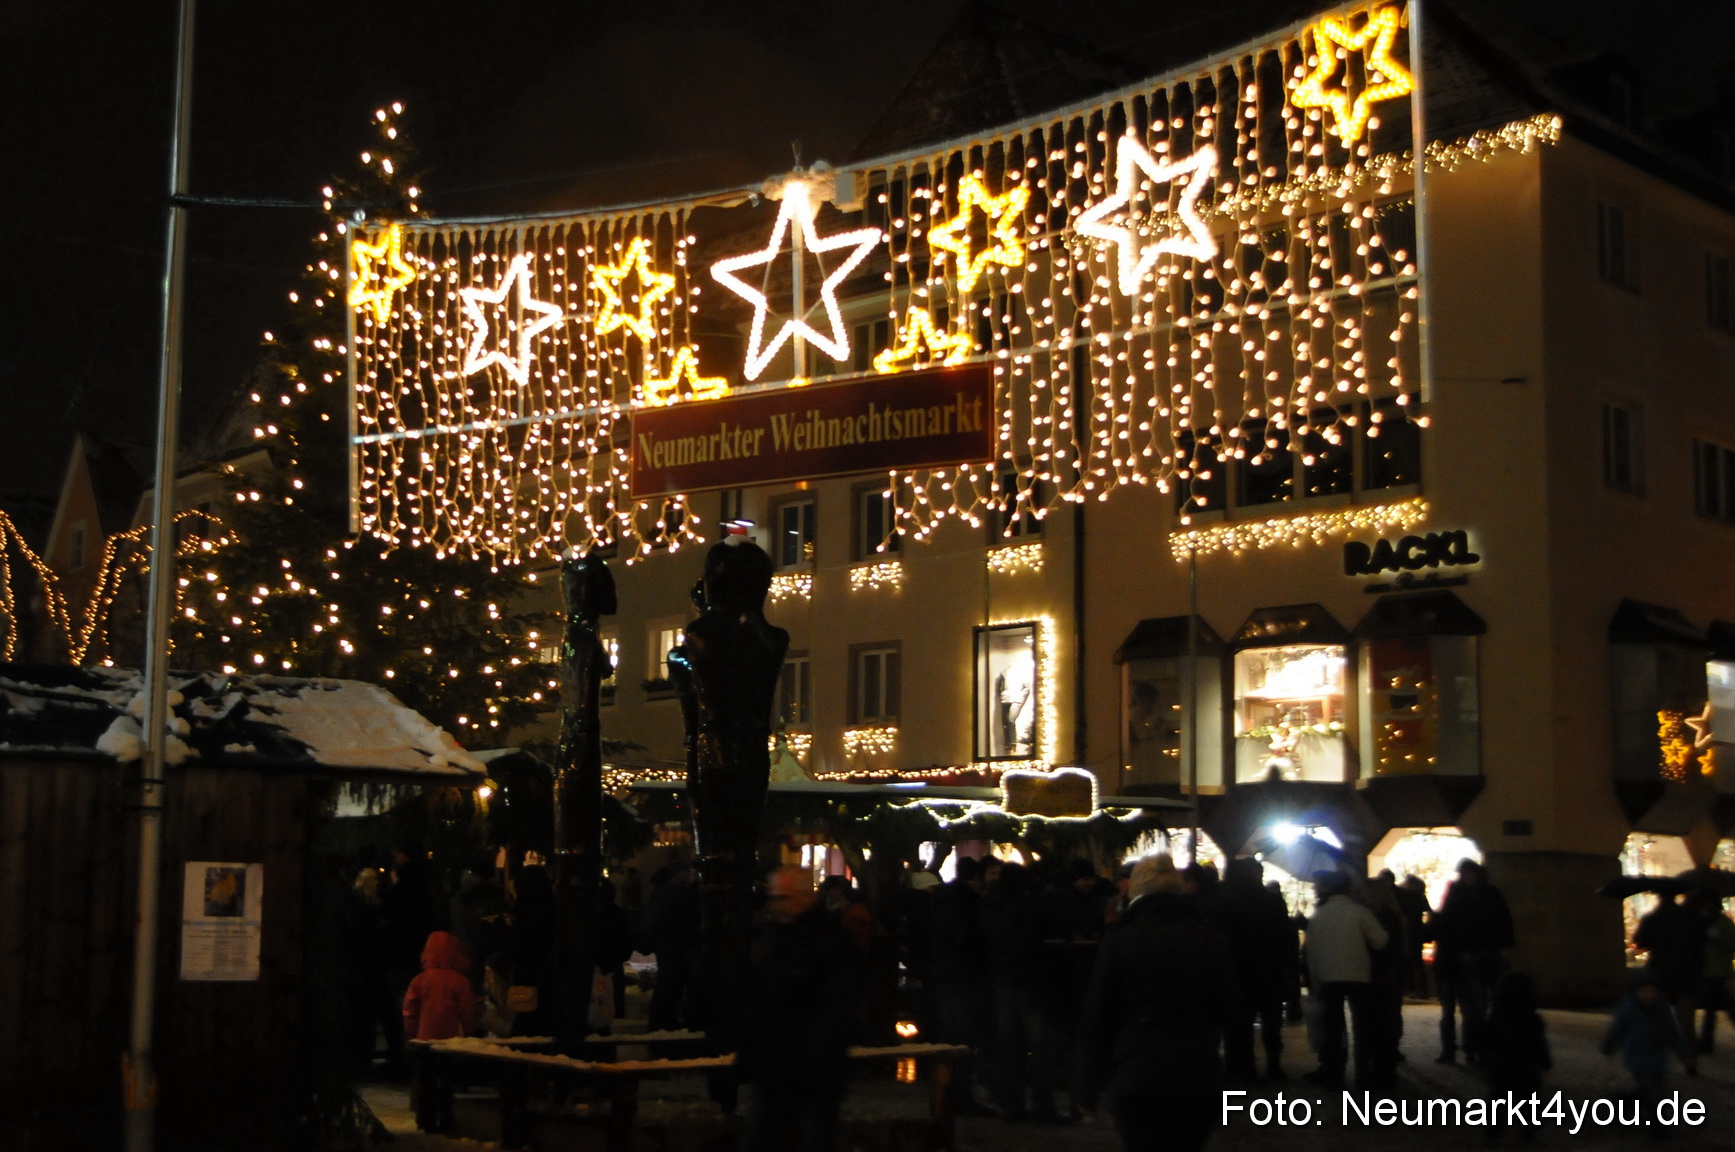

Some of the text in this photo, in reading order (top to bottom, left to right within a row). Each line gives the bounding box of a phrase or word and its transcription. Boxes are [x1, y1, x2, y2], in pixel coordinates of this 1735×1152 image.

[637, 392, 983, 472] Neumarkter Weihnachtsmarkt
[1344, 530, 1480, 576] RACKL
